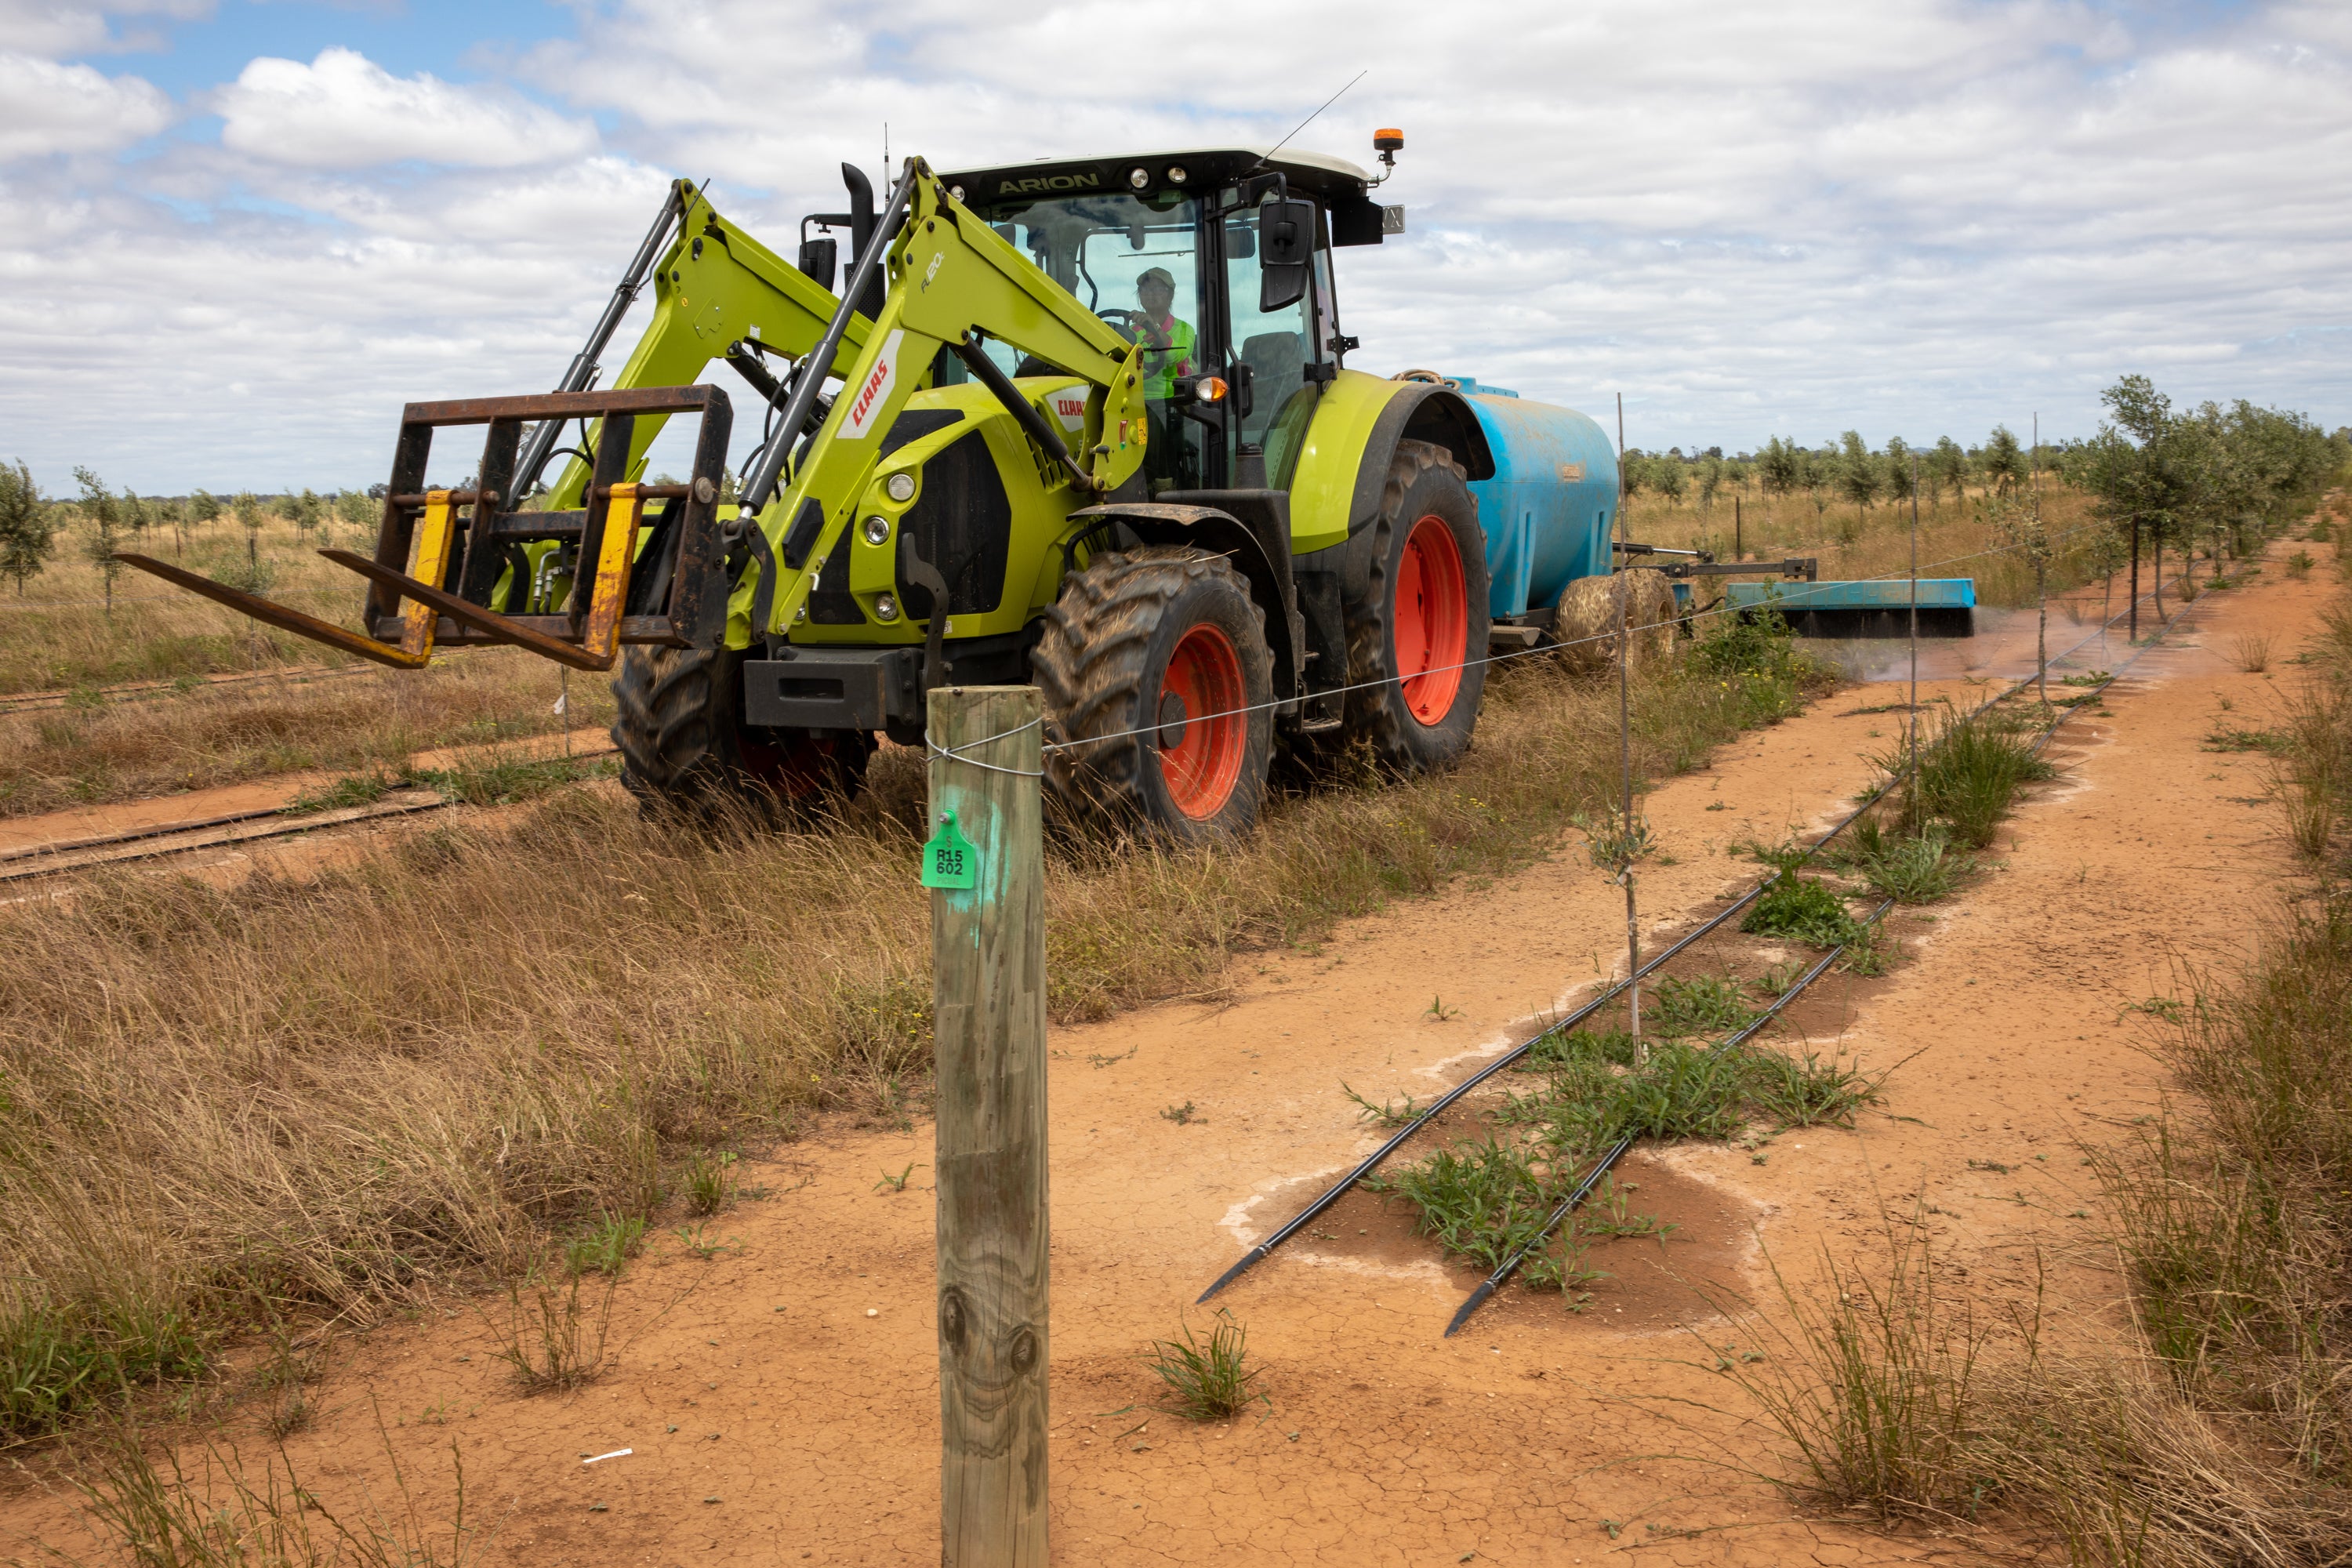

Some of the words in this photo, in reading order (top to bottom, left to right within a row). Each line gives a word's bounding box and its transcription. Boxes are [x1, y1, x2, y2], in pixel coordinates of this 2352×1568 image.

[999, 173, 1099, 194] ARION
[852, 358, 887, 427] CLAAS
[946, 835, 953, 848] S
[937, 849, 963, 862] R15
[937, 862, 963, 875] 602
